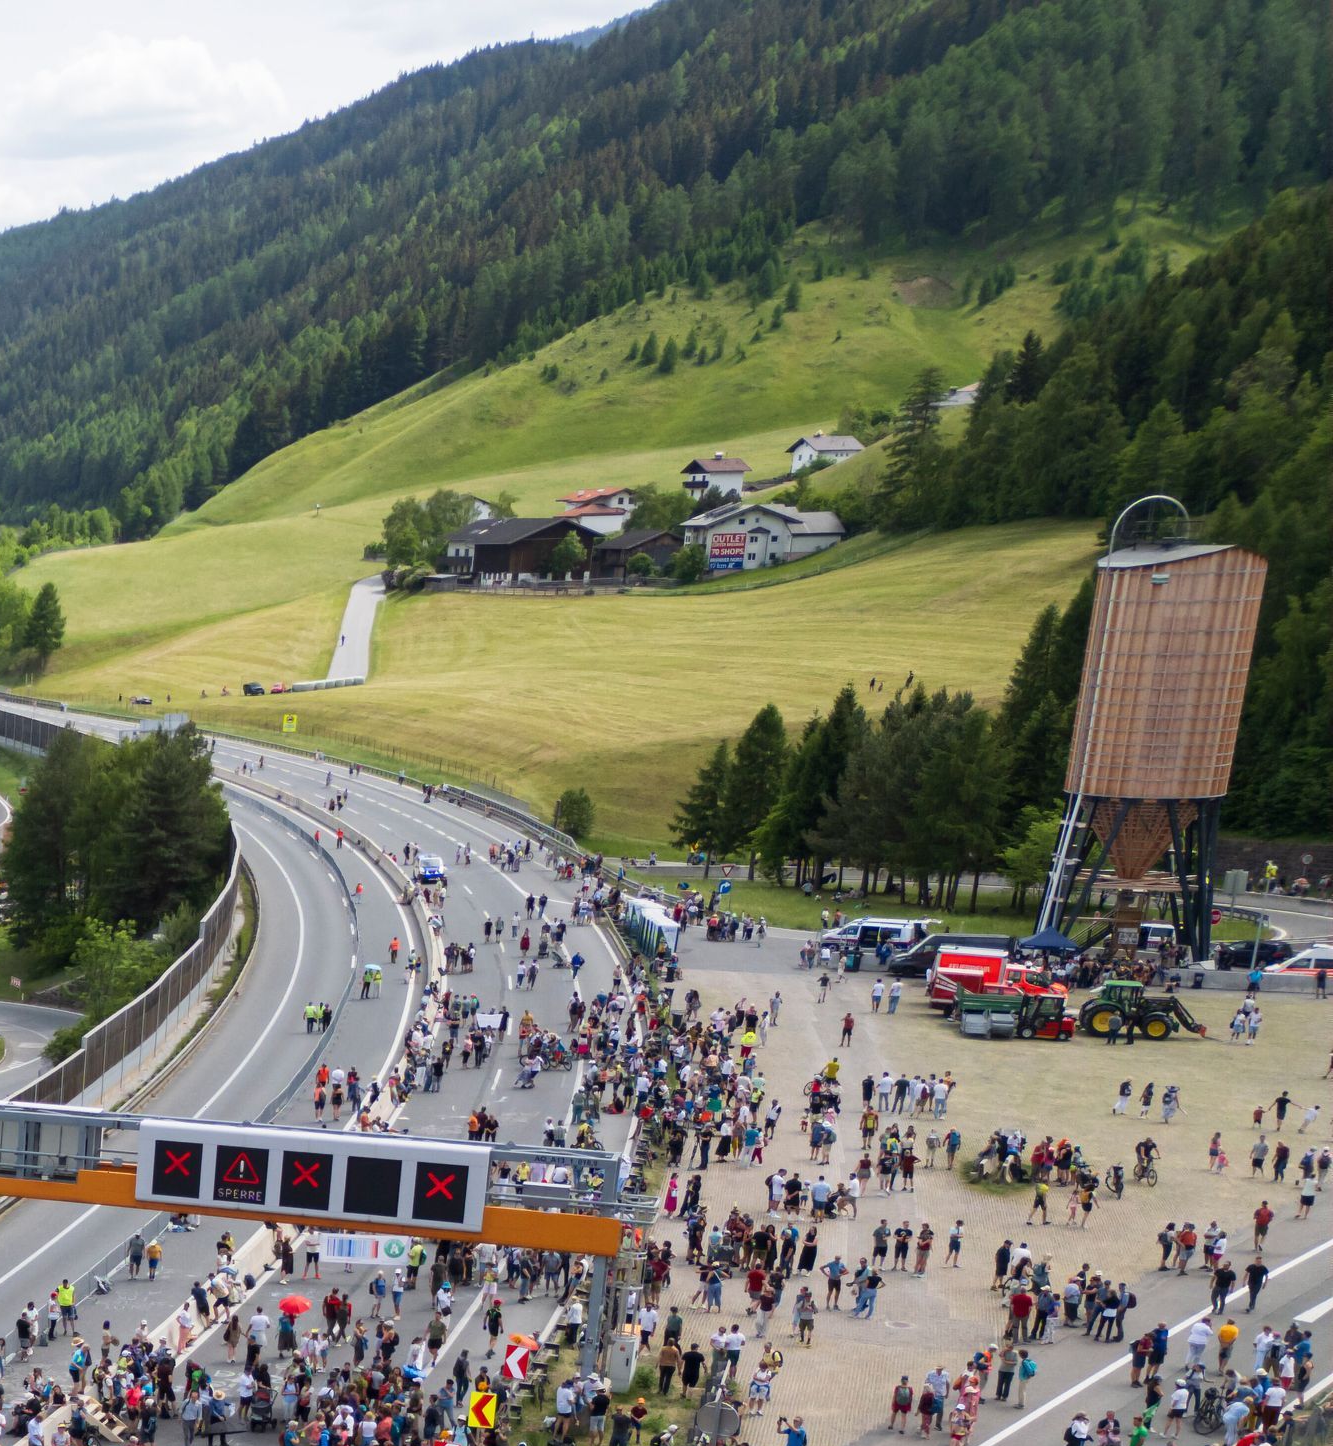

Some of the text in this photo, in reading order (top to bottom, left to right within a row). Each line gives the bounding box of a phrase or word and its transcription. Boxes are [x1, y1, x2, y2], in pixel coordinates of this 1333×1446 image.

[713, 534, 745, 543] OUTLET
[721, 547, 744, 555] SHOPS
[218, 1188, 262, 1201] SPERRE
